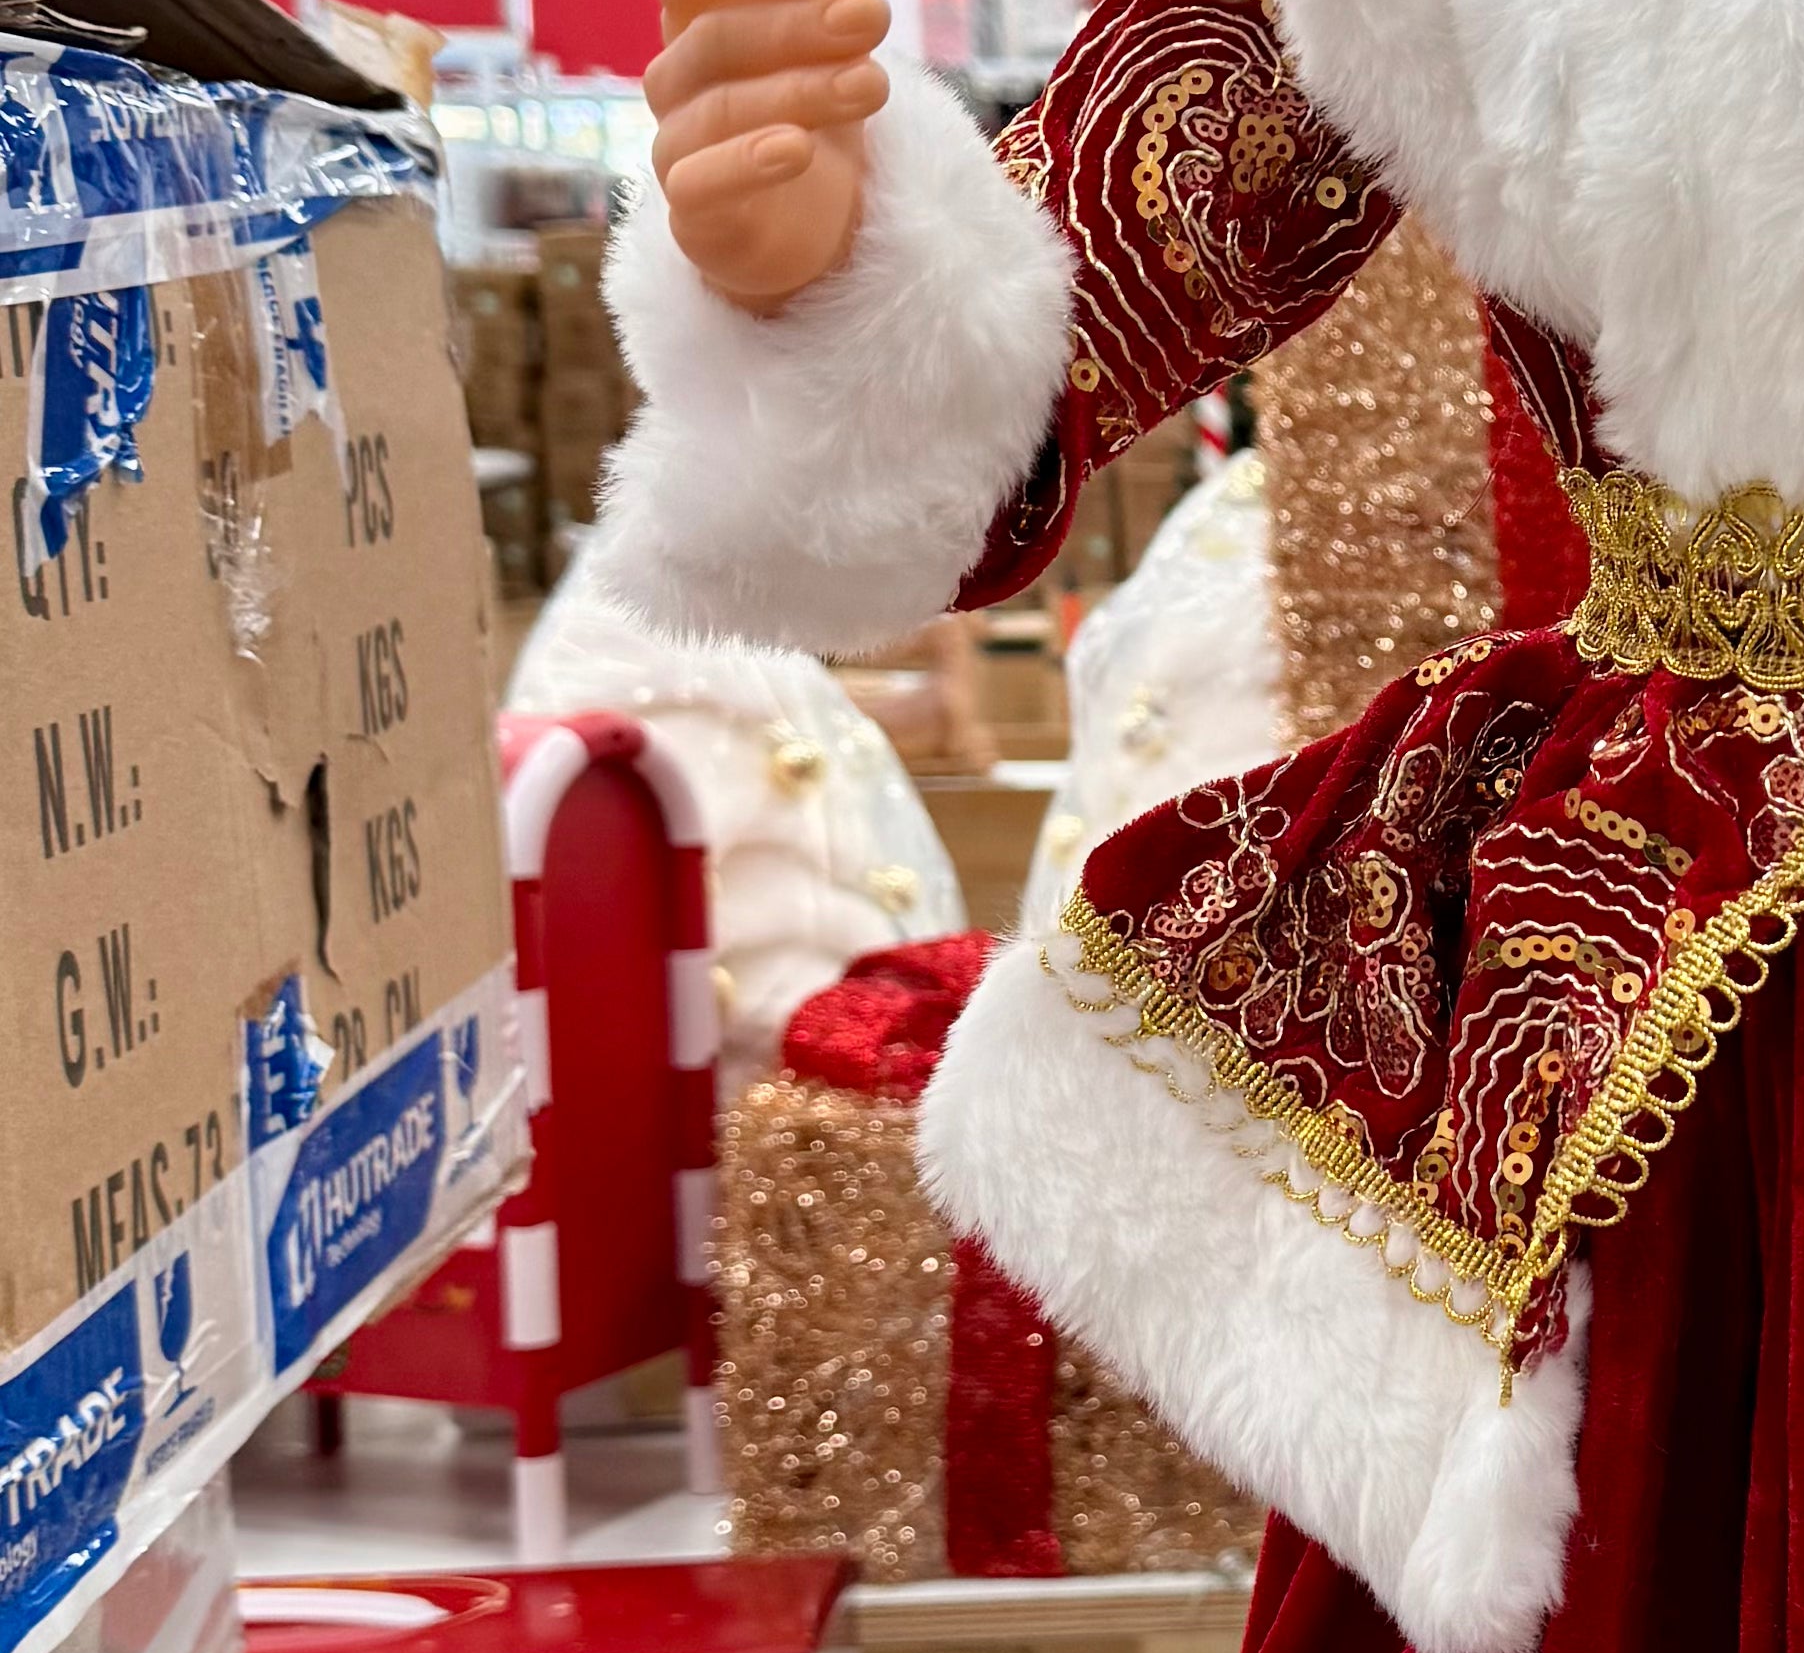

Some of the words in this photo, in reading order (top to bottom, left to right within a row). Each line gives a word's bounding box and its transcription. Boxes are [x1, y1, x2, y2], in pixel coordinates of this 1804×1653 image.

[345, 432, 394, 547] PCS
[34, 705, 142, 859] N.W.:
[357, 617, 409, 737] KGS
[56, 923, 160, 1089] G.W.:
[365, 796, 421, 925] KGS
[324, 1092, 435, 1238] HUTRADE
